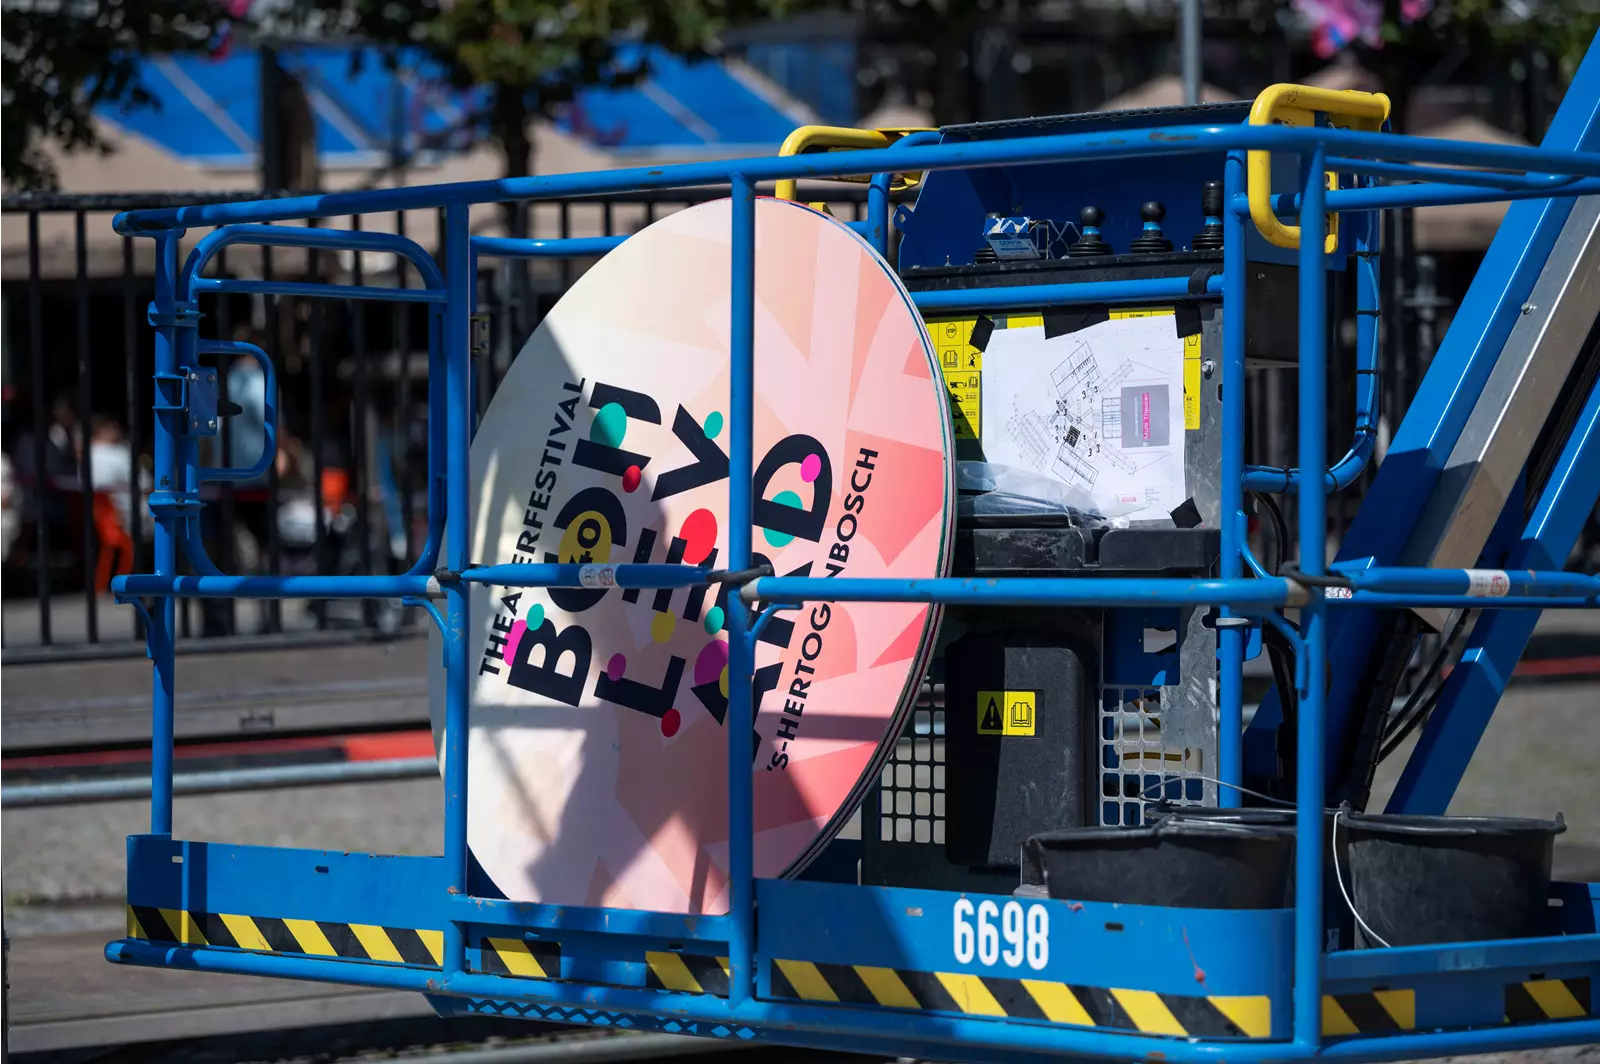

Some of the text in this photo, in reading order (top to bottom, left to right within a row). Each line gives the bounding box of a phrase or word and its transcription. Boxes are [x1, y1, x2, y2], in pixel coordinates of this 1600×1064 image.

[479, 377, 586, 676] THEAERFESTIVAL
[766, 447, 879, 772] 'S-HERTOGNBOSCH
[953, 897, 1050, 971] 6698
